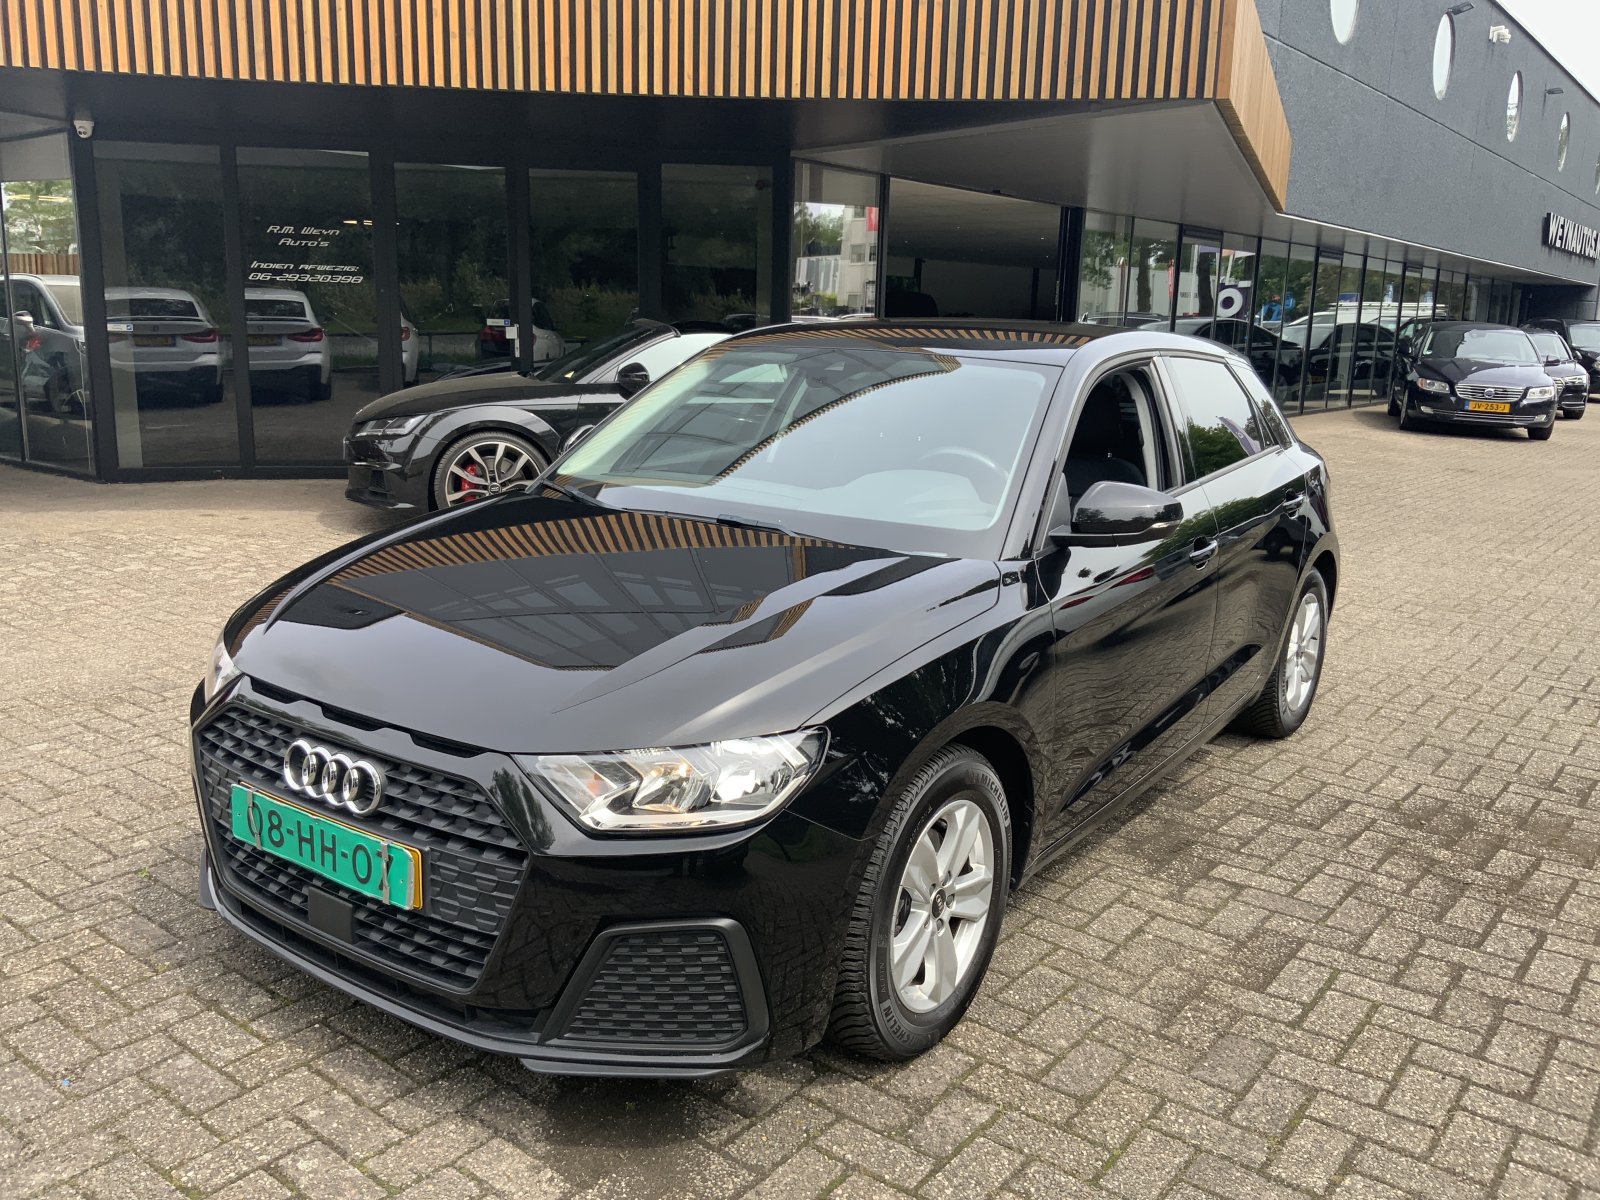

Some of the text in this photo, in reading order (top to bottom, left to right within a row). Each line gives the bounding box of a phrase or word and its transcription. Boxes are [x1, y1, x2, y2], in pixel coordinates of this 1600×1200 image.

[267, 225, 295, 234] R.M.
[248, 272, 364, 284] 06-29320398
[1472, 403, 1506, 412] JV-253-J
[982, 773, 1009, 821] MICHELIN
[247, 801, 393, 891] 08-HH-07
